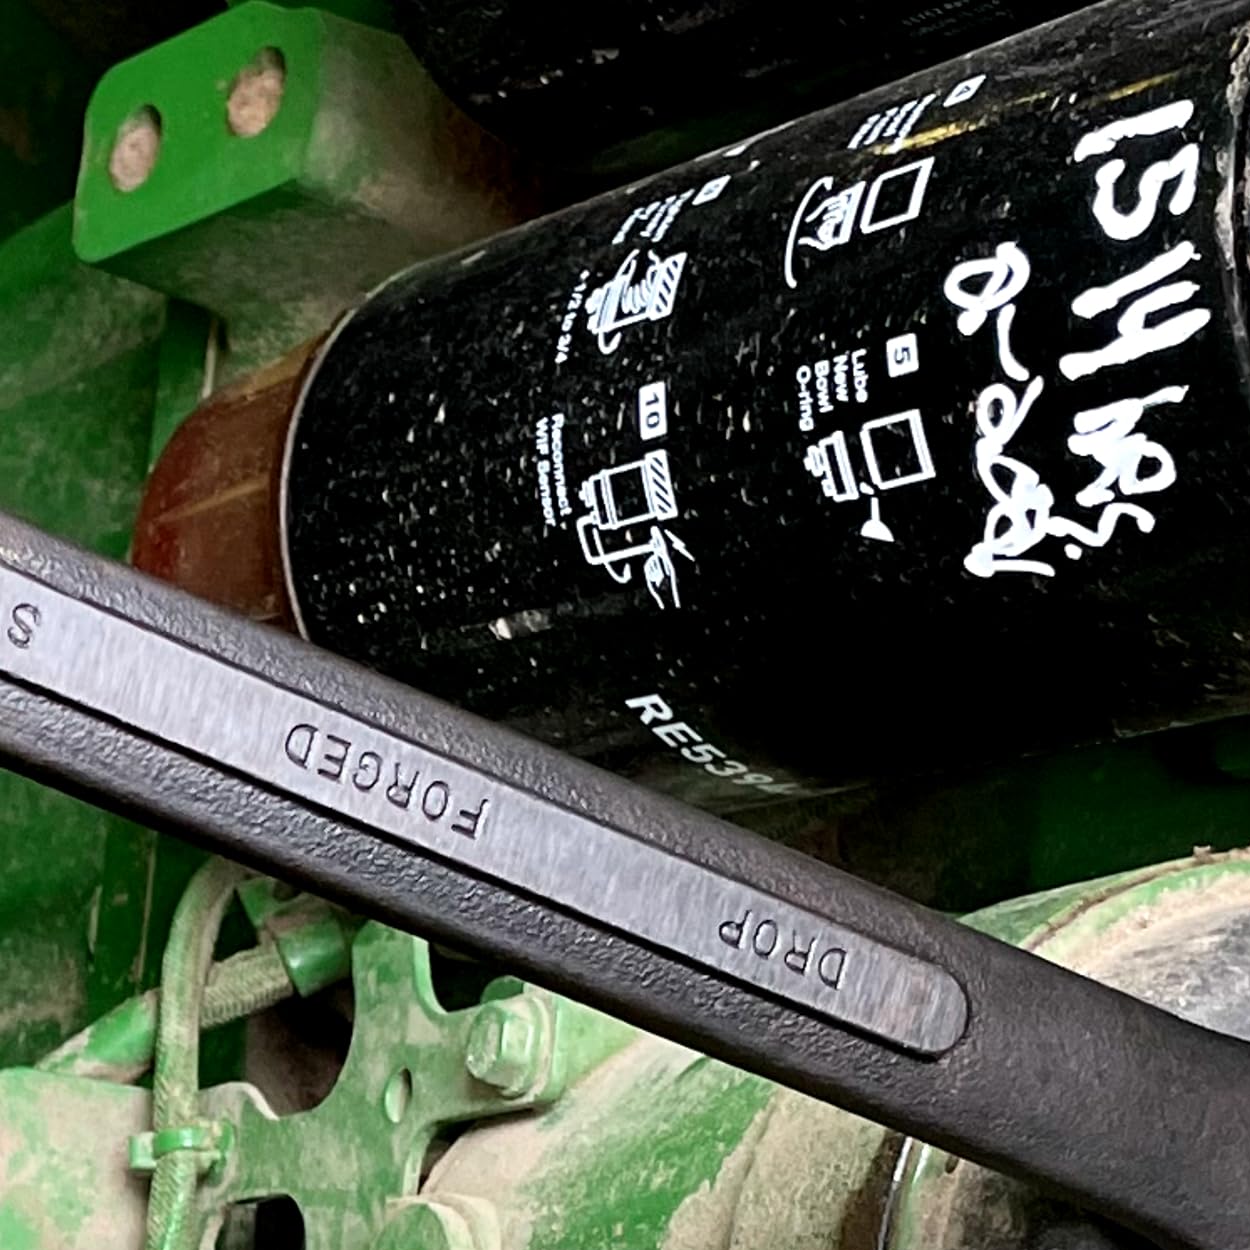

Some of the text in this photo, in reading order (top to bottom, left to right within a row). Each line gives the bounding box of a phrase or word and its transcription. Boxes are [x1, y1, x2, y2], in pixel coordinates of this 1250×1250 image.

[1059, 99, 1212, 381] 1514
[795, 364, 815, 432] O-ring
[814, 359, 835, 414] Bowl
[832, 353, 850, 402] New
[851, 348, 870, 403] Lube
[536, 460, 557, 527] Sensor
[551, 412, 573, 517] Reconnect
[284, 723, 490, 840] FORGED
[718, 909, 848, 991] DROP
